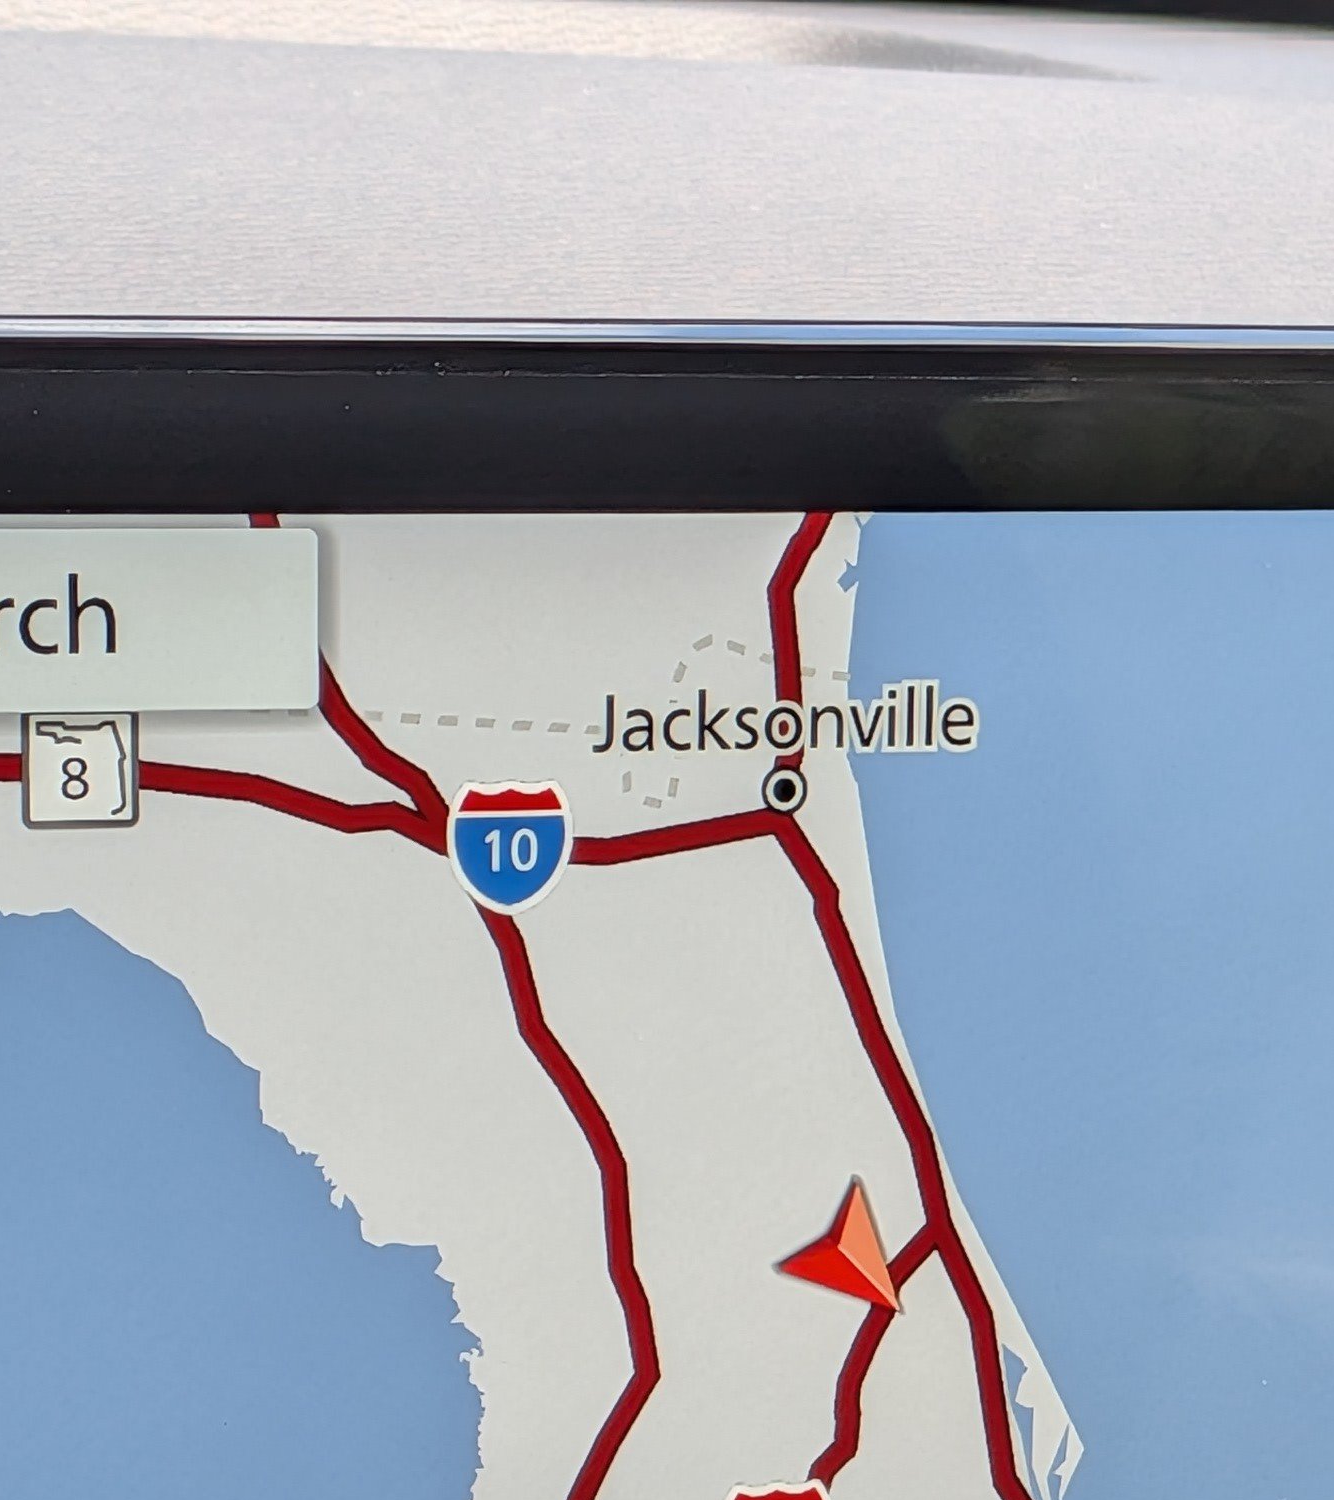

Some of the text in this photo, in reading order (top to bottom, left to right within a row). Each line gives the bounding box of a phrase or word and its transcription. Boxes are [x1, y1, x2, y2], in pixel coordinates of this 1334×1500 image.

[592, 684, 977, 753] Jacksonville
[60, 757, 89, 800] 8
[483, 828, 538, 874] 10
